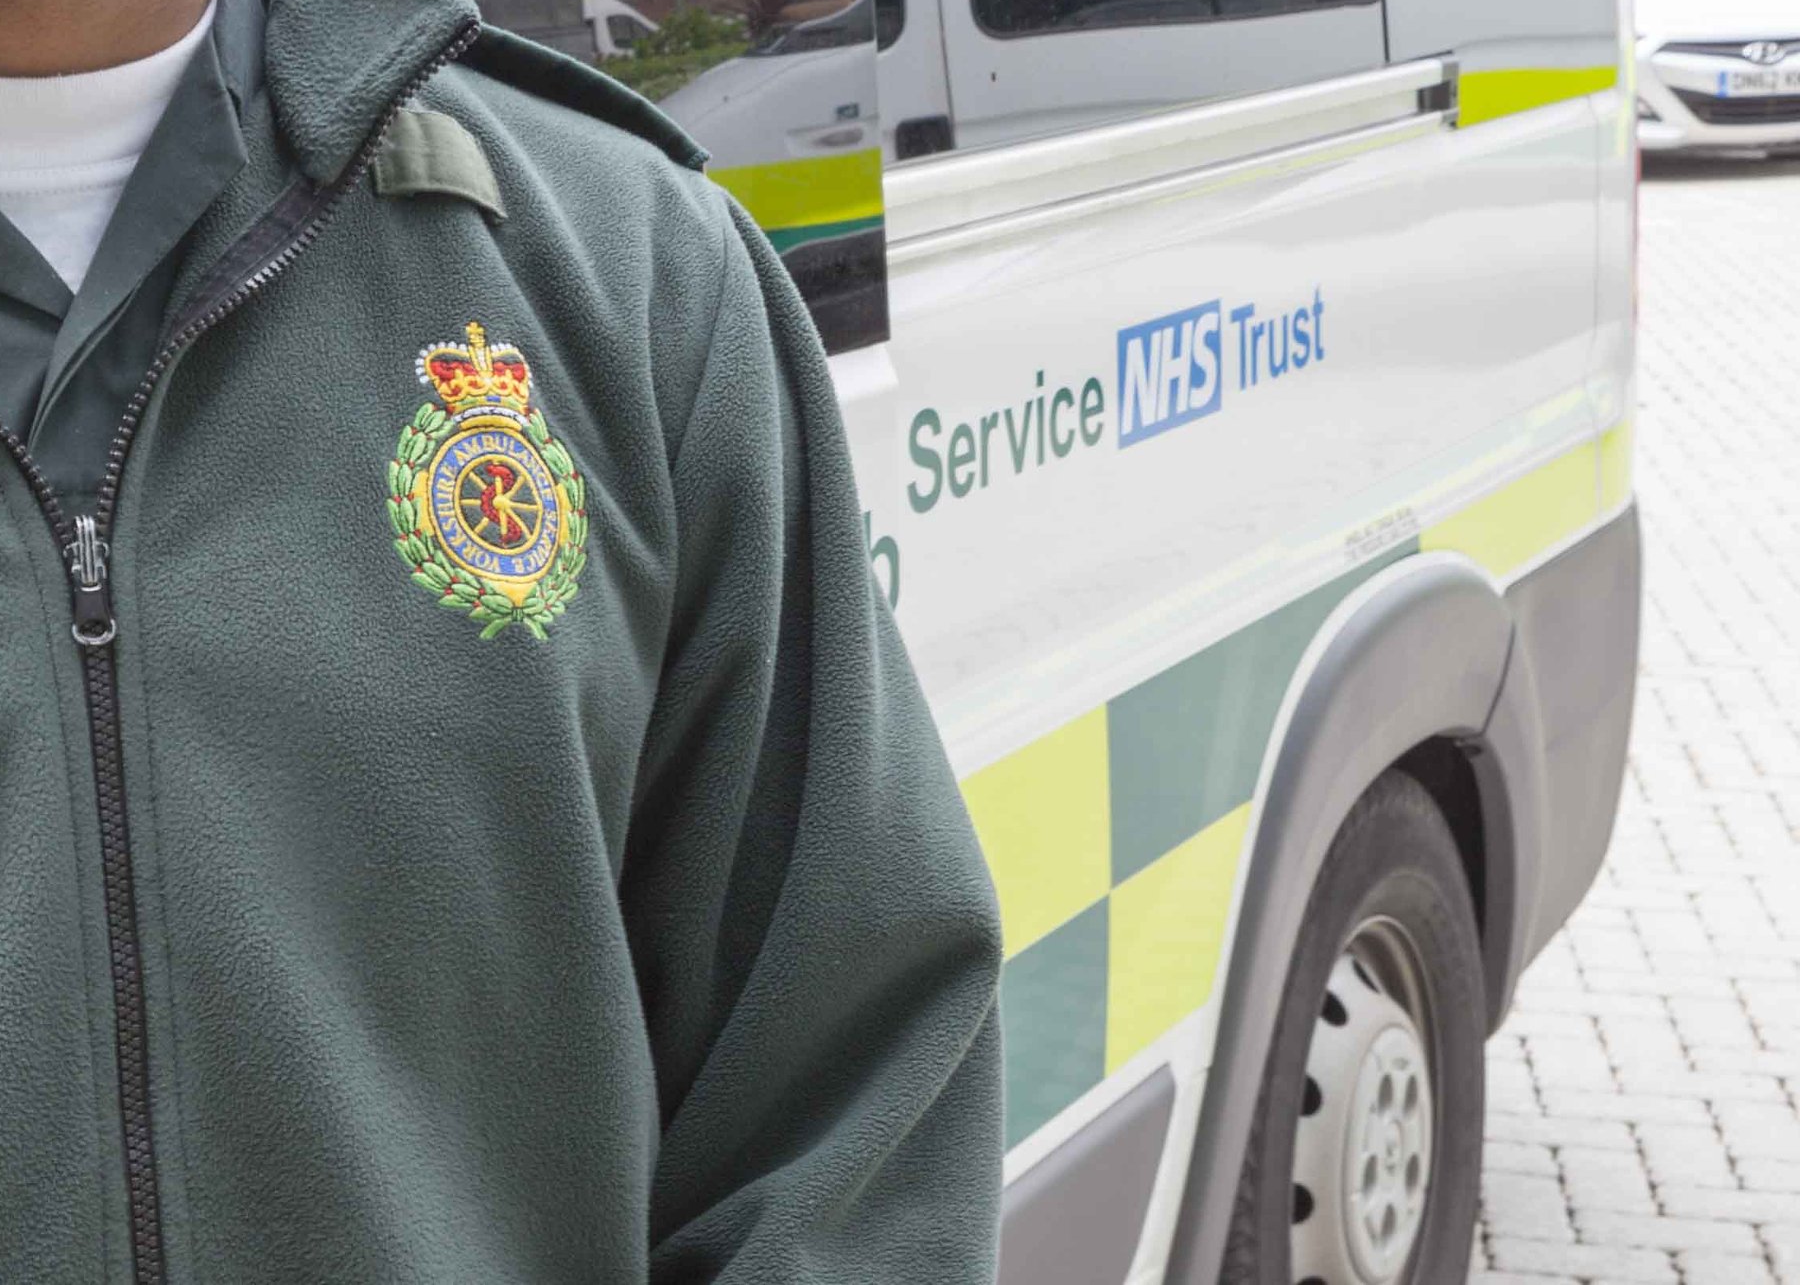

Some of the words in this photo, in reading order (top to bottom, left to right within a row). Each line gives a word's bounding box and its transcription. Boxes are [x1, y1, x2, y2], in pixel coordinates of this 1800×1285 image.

[906, 369, 1104, 514] Service
[1120, 311, 1220, 437] NHS
[1230, 286, 1325, 392] Trust
[434, 461, 502, 574] YORKSHIRE
[452, 434, 553, 500] AMBULANCE
